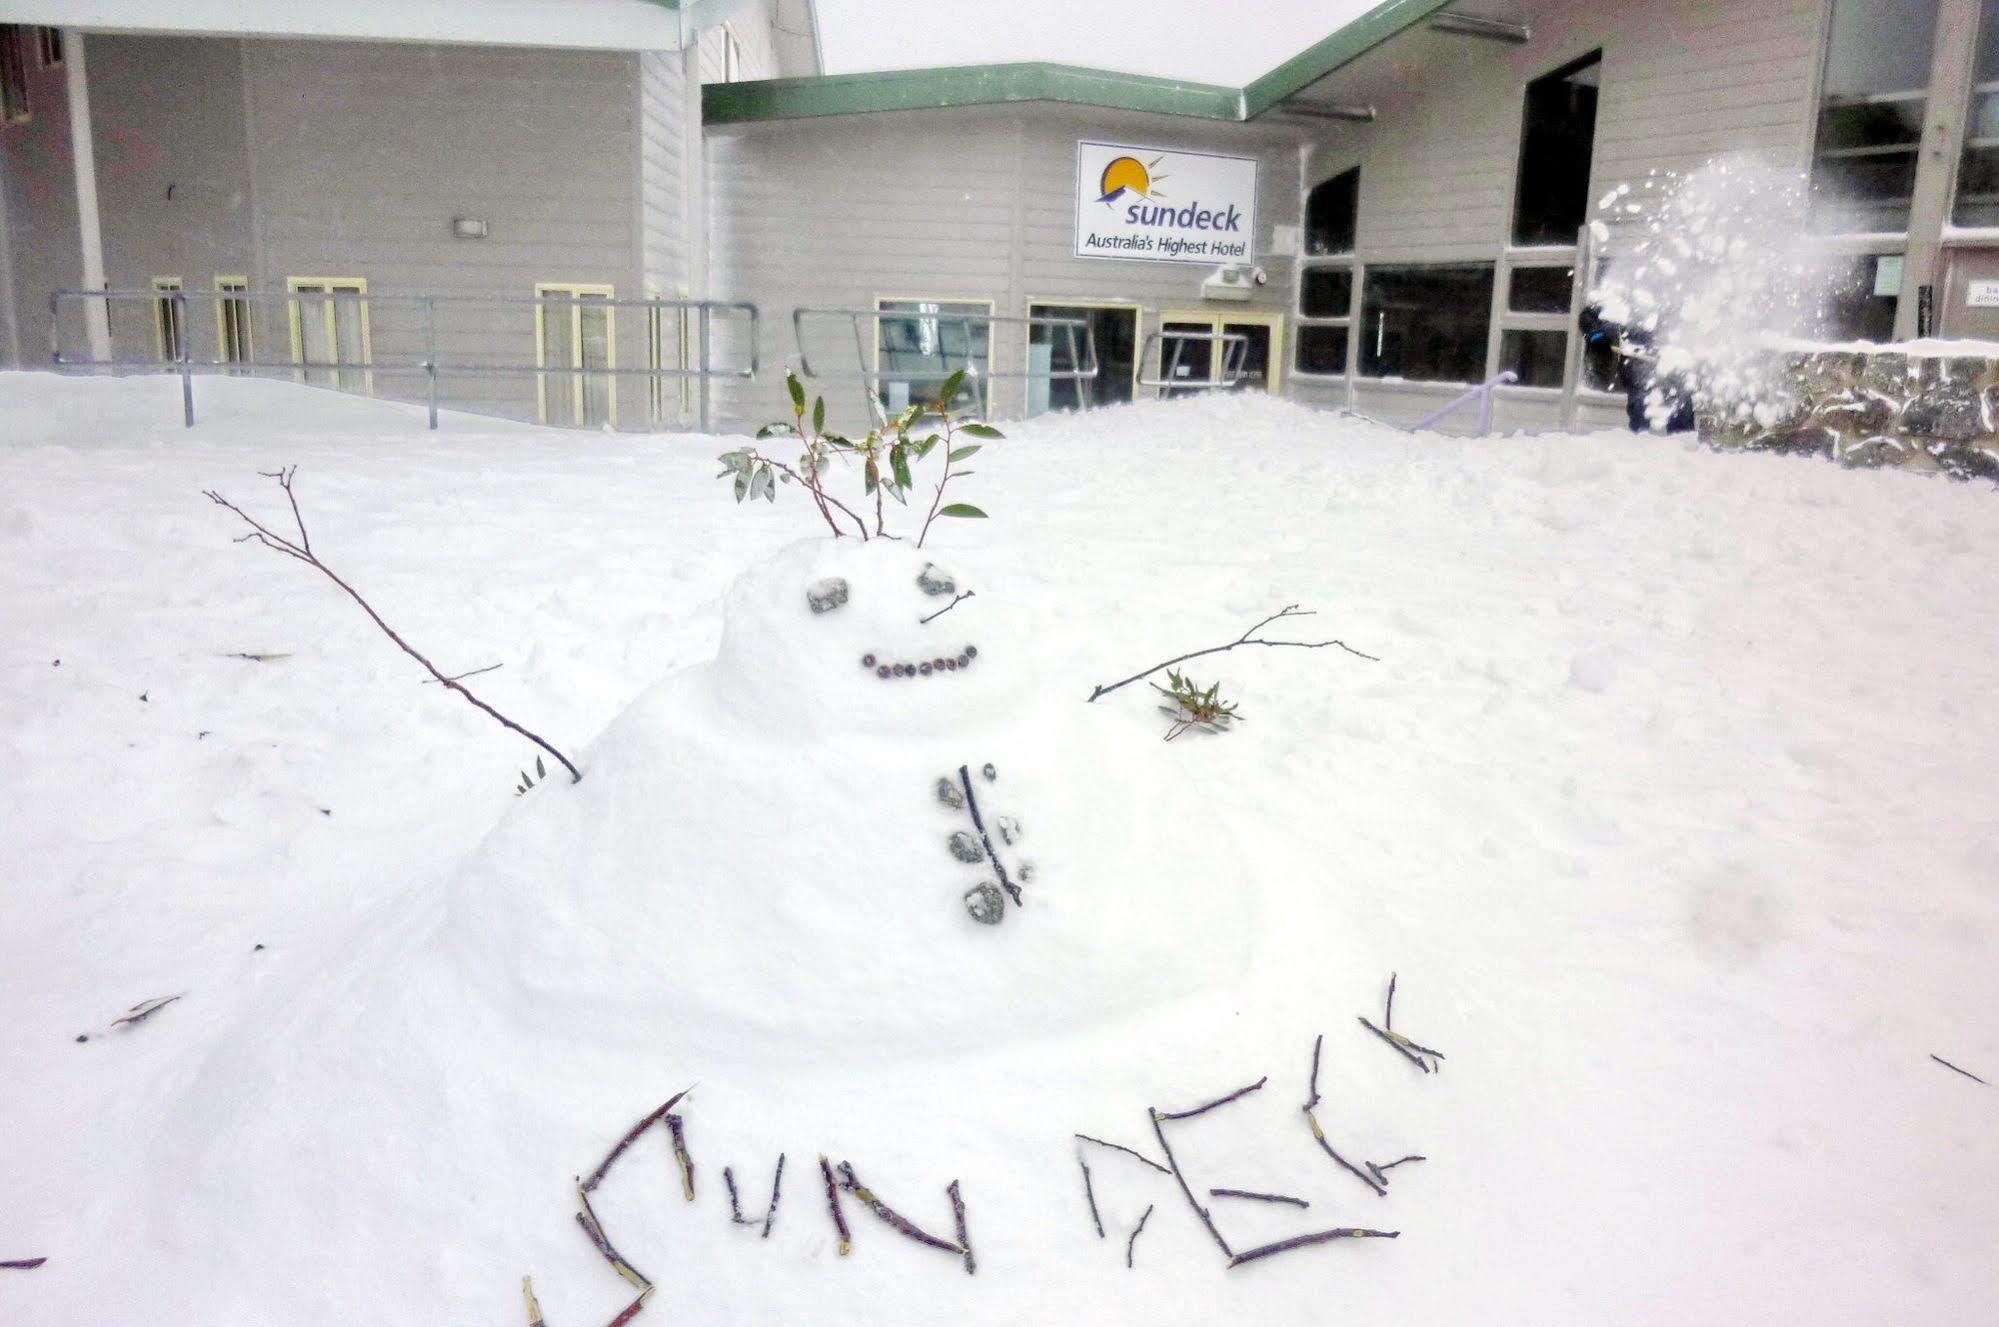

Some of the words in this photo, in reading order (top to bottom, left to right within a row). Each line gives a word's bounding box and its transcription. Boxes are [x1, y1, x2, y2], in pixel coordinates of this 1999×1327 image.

[1125, 201, 1242, 232] sundeck
[1085, 232, 1154, 251] Australia's
[1157, 236, 1208, 257] Highest
[1211, 240, 1246, 257] Hotel
[522, 1081, 976, 1327] SUN
